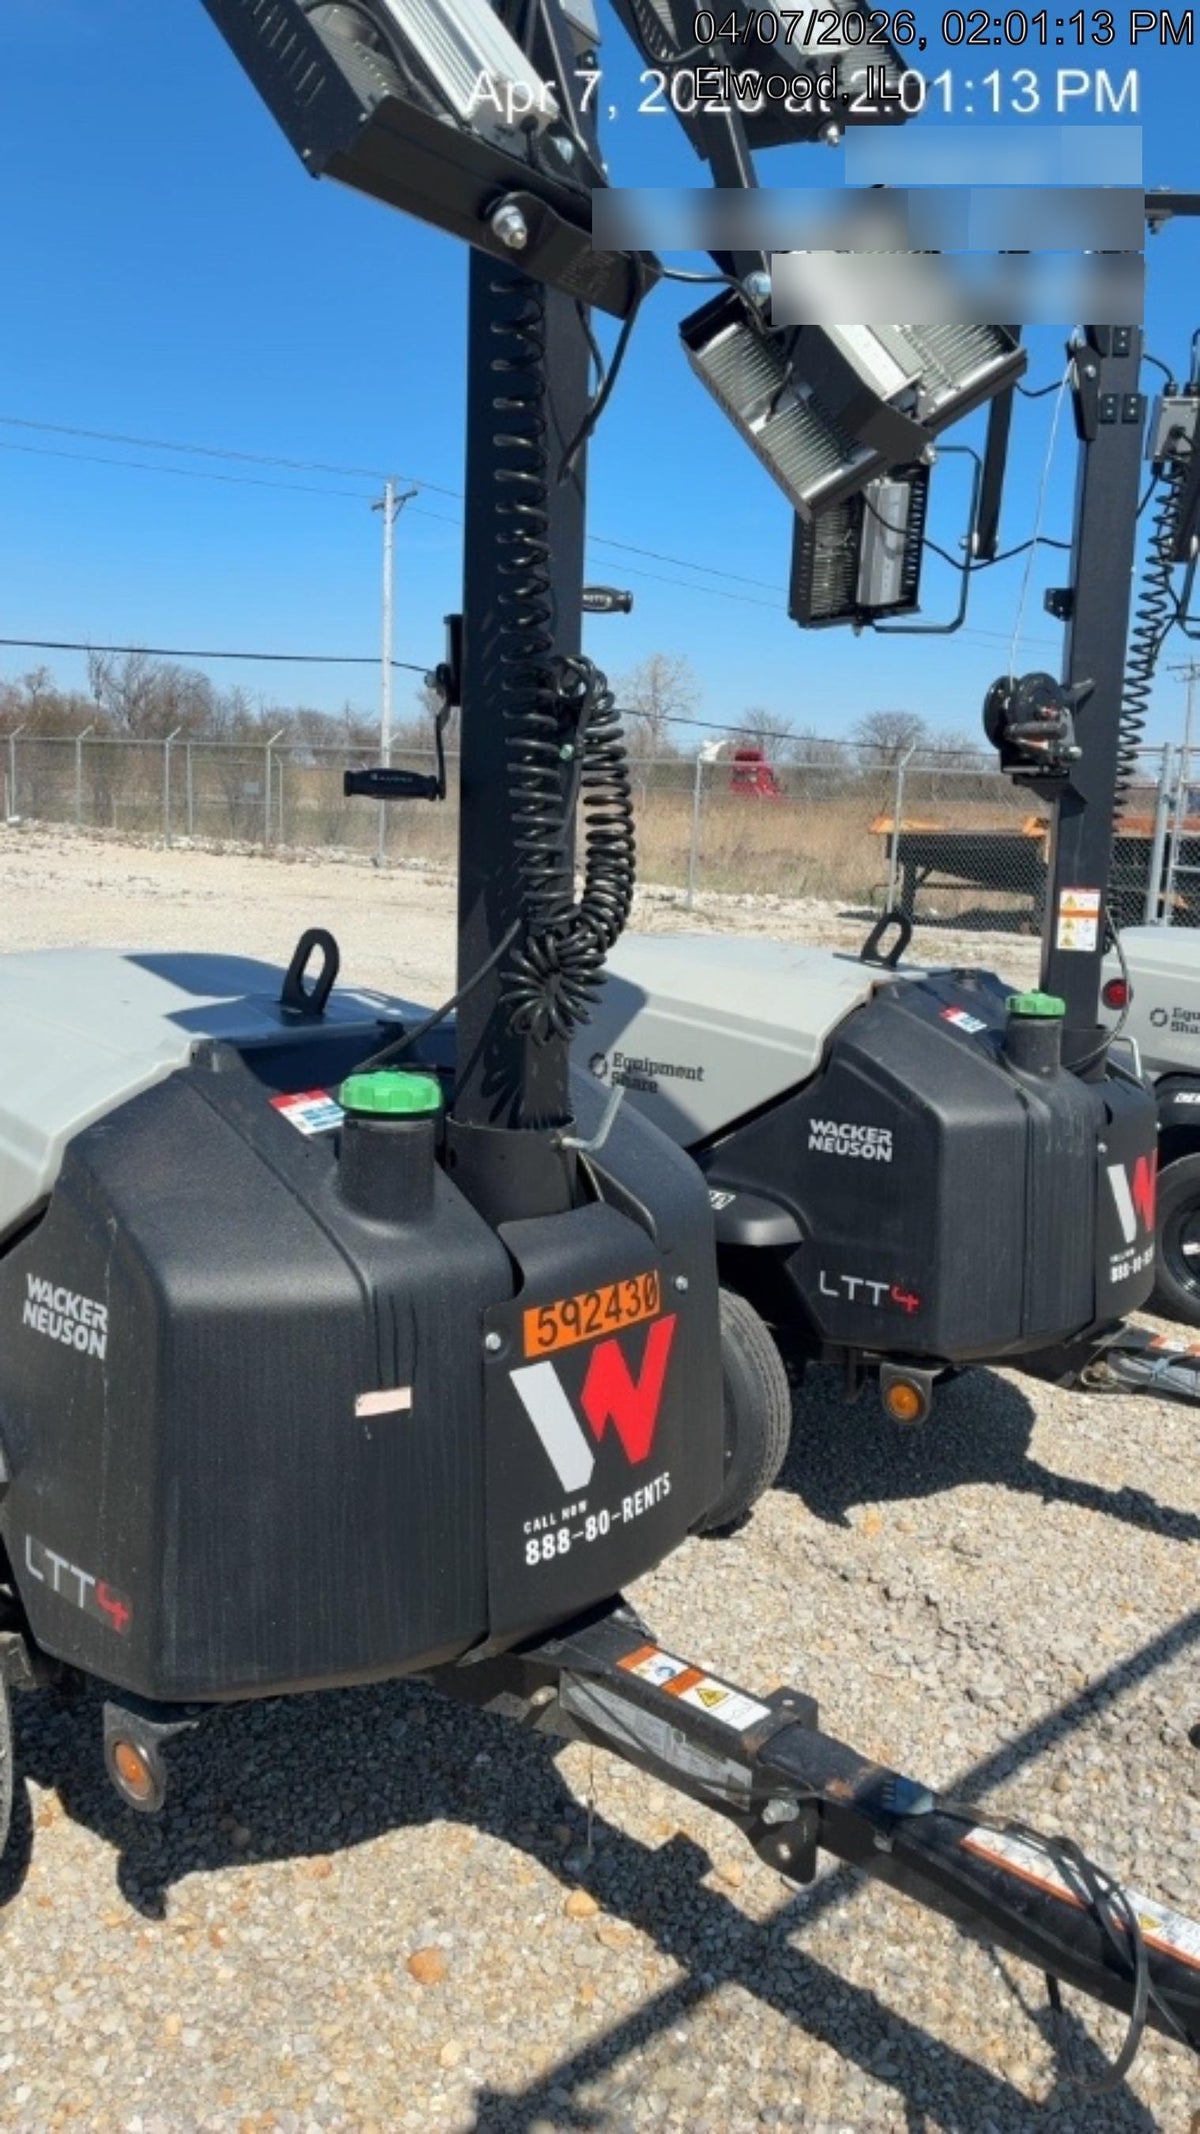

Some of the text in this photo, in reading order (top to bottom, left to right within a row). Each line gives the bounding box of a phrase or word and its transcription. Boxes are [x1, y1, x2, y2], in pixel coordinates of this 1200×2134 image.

[611, 1071, 658, 1094] Share
[613, 1052, 705, 1082] Equipment
[808, 1135, 893, 1163] NEUSON
[809, 1118, 893, 1146] WACKER
[26, 1272, 109, 1333] WACKER
[537, 1272, 657, 1348] 592430
[819, 1270, 920, 1313] LTT4
[23, 1299, 107, 1360] NEUSON
[523, 1499, 588, 1535] CALL NOW
[525, 1471, 672, 1566] 888-80-RENTS
[25, 1533, 130, 1633] LTT4
